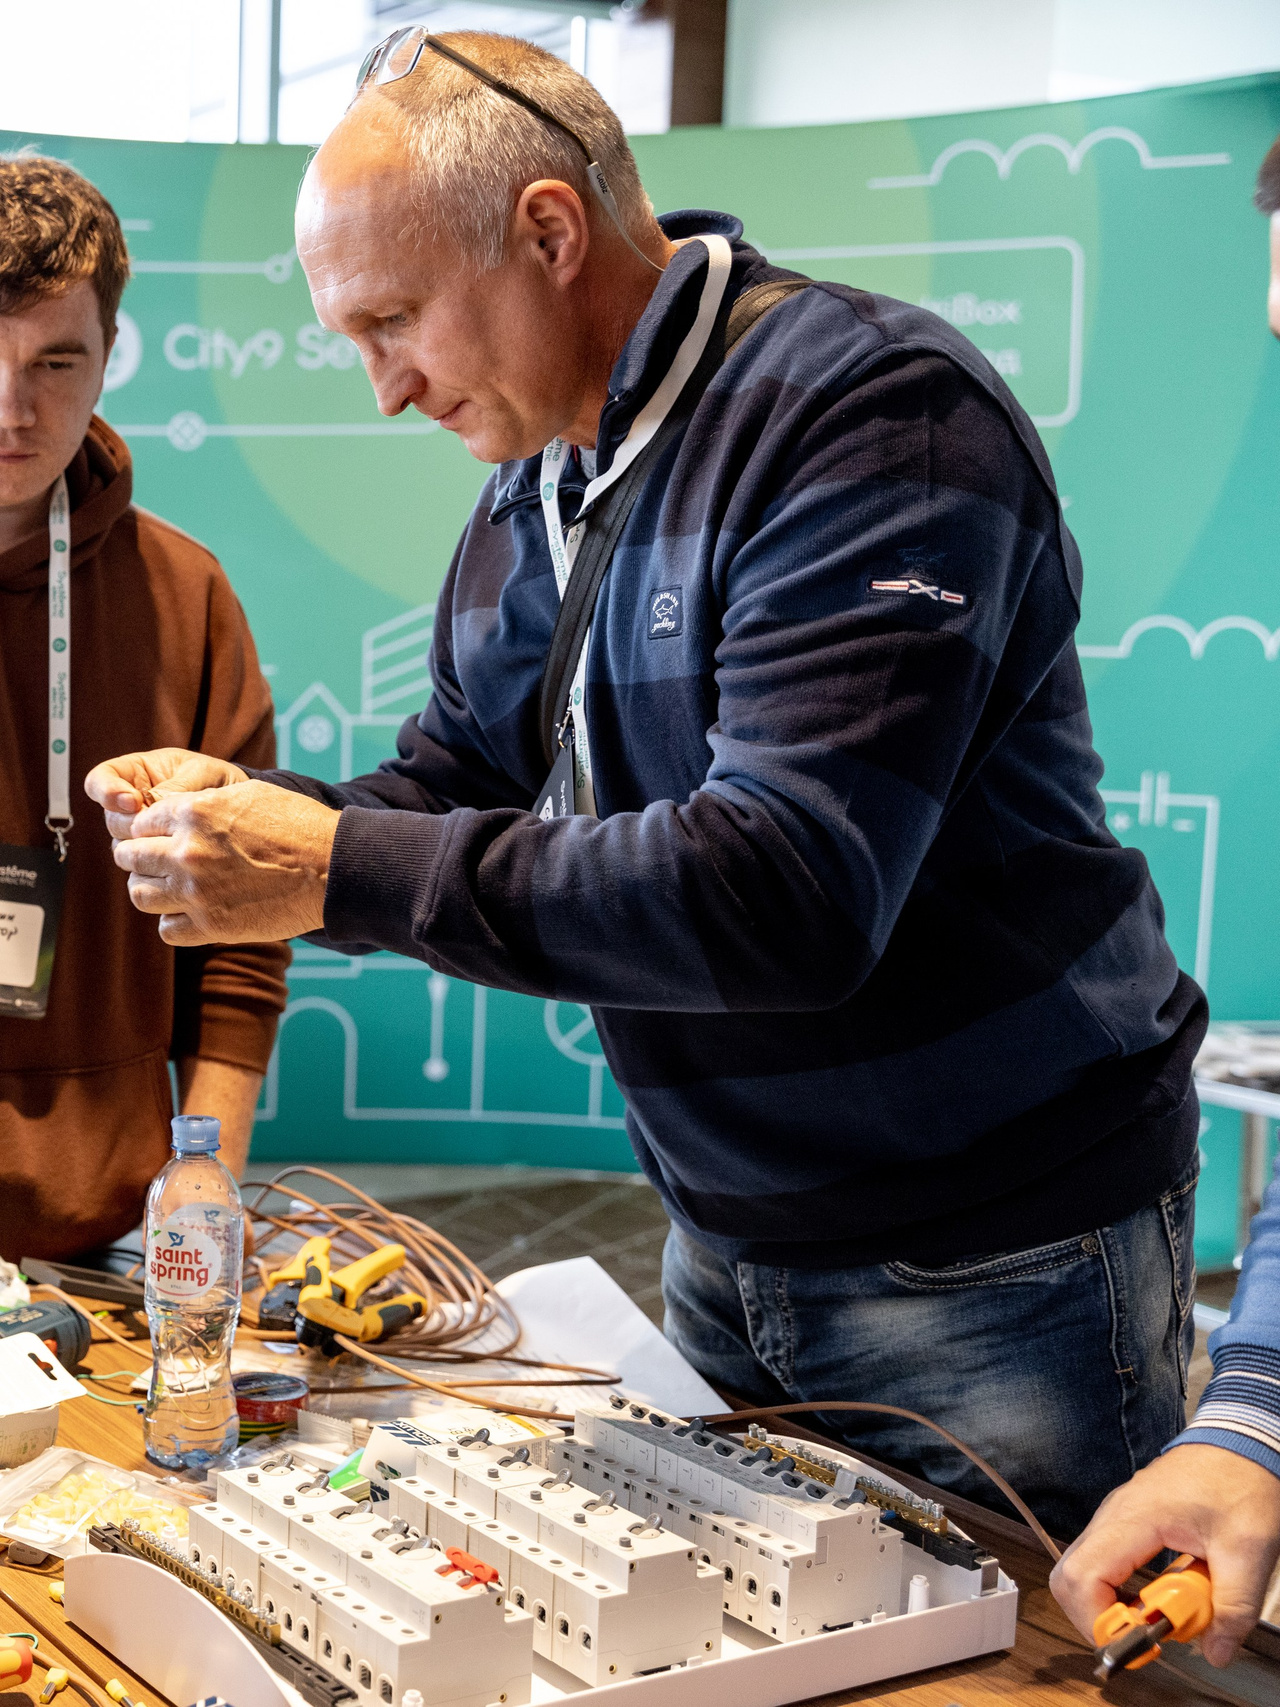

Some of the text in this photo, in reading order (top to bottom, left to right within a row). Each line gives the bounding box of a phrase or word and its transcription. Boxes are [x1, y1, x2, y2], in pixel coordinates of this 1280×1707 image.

[163, 322, 358, 378] City9 Se
[155, 1246, 203, 1265] saint
[150, 1261, 209, 1287] spring
